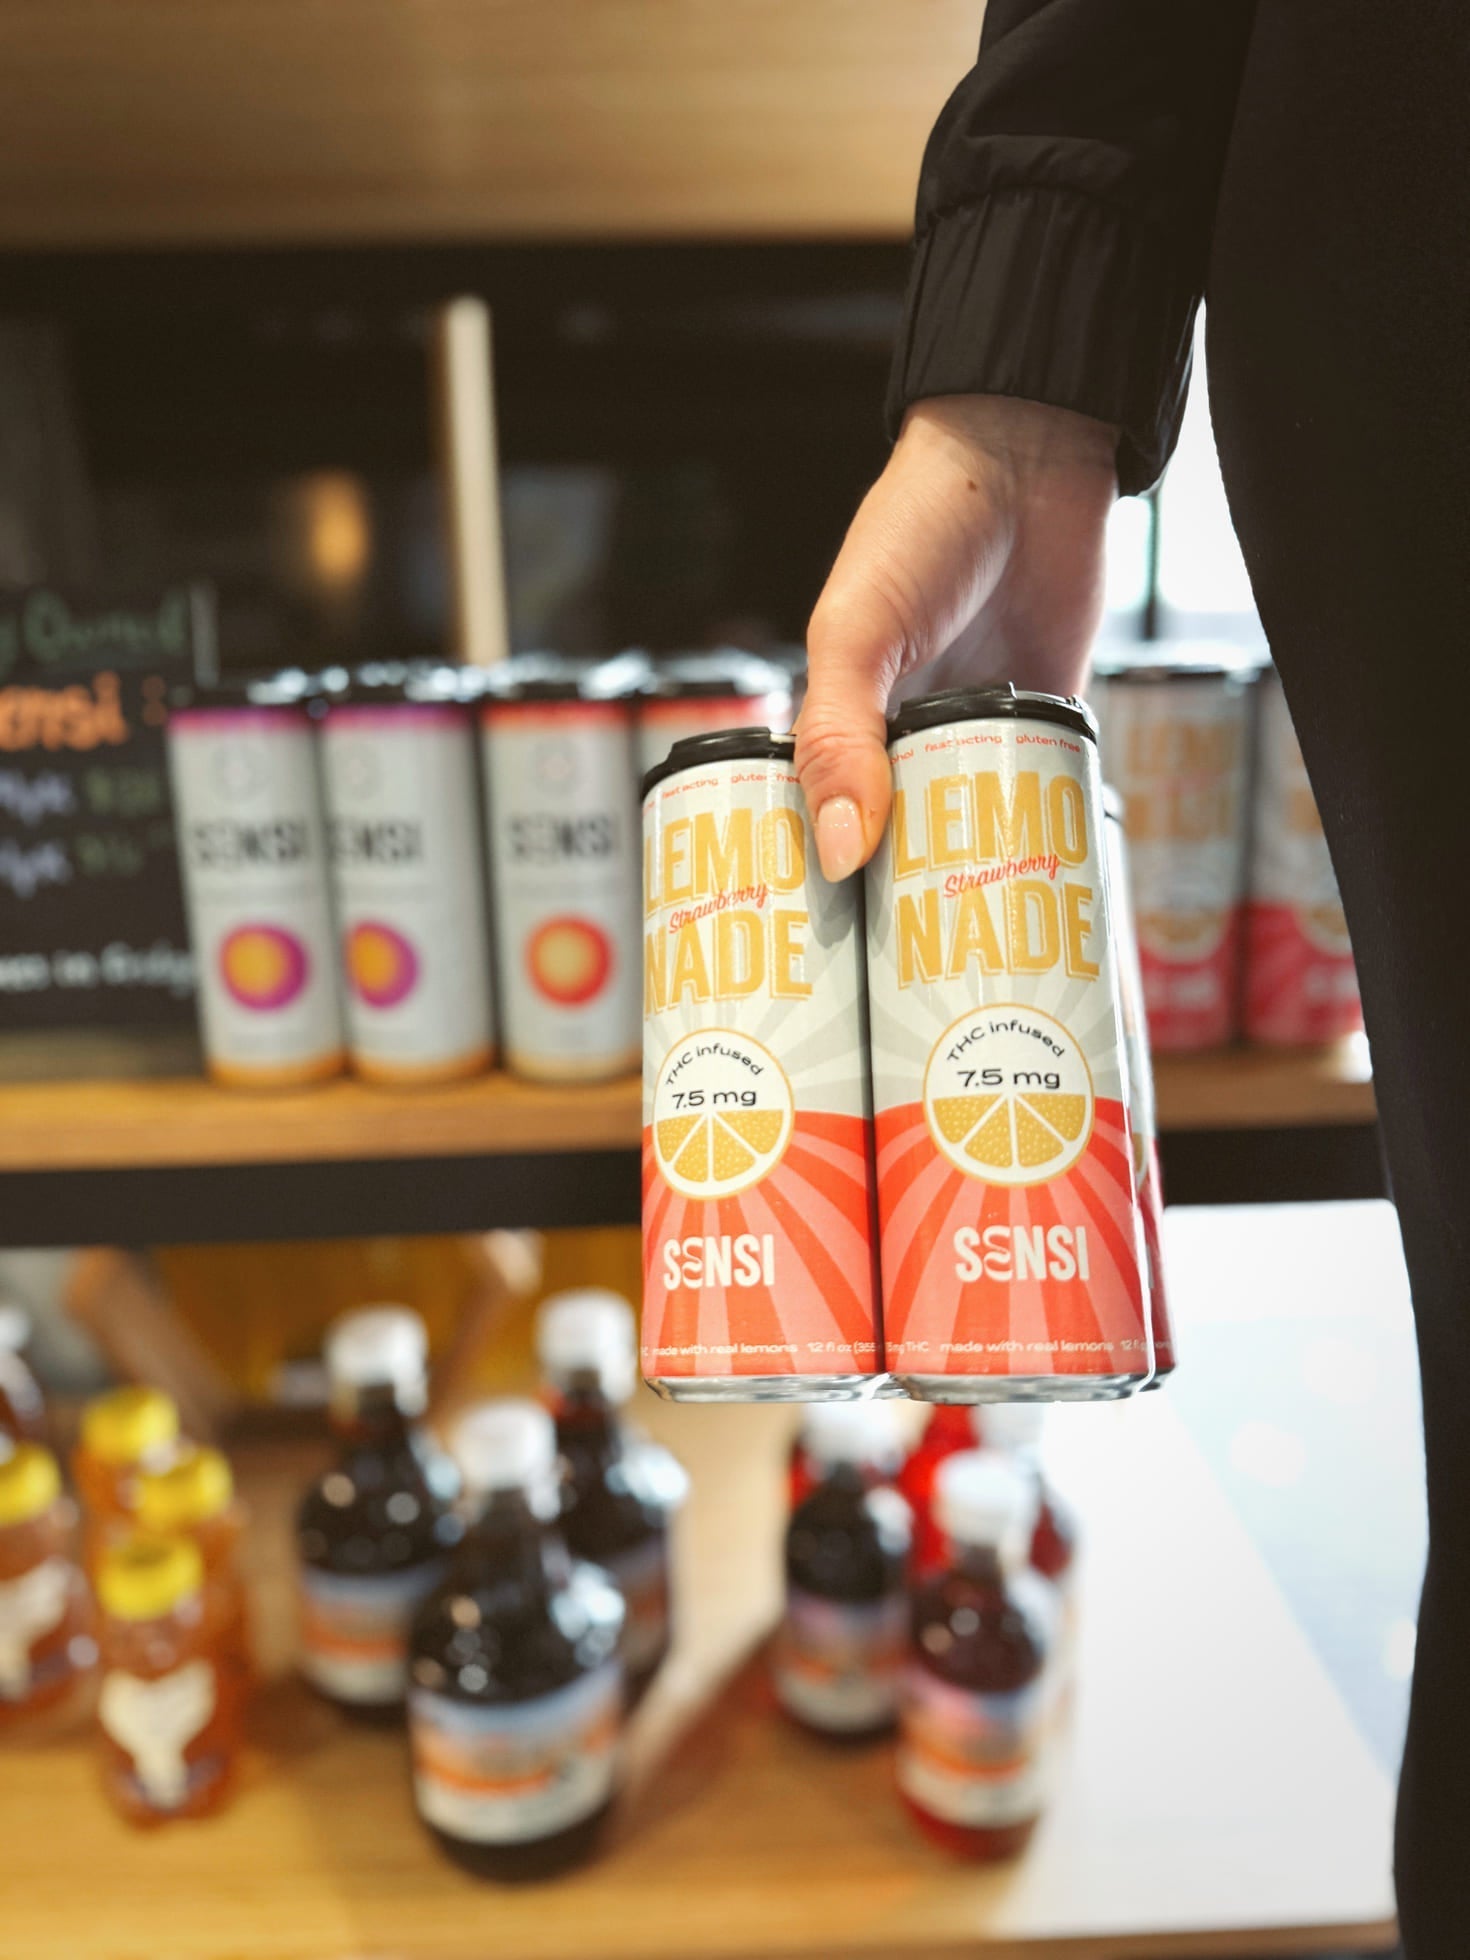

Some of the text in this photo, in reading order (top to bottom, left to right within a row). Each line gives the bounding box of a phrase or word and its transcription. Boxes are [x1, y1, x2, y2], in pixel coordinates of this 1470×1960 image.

[956, 734, 1003, 746] acting
[1016, 733, 1058, 747] gluten
[1059, 738, 1081, 753] free
[891, 771, 1089, 882] LEMO
[643, 807, 807, 919] LEMO
[944, 853, 1061, 899] Strawberry
[668, 883, 769, 935] Strawberry
[896, 880, 1101, 991] NADE
[643, 908, 814, 1017] NADE
[946, 1019, 1065, 1060] THC infused
[666, 1042, 764, 1086] THC infused
[957, 1068, 1060, 1090] 7.5 mg
[672, 1089, 757, 1110] 7.5 mg
[663, 1233, 775, 1291] SENSI
[953, 1224, 1089, 1282] SENSI
[653, 1345, 677, 1357] made
[680, 1342, 709, 1356] with
[711, 1341, 738, 1354] real
[740, 1341, 799, 1354] lemons
[906, 1340, 929, 1353] THC
[940, 1340, 985, 1353] made
[987, 1340, 1023, 1353] with
[1027, 1340, 1058, 1353] real
[1061, 1340, 1113, 1353] lemons
